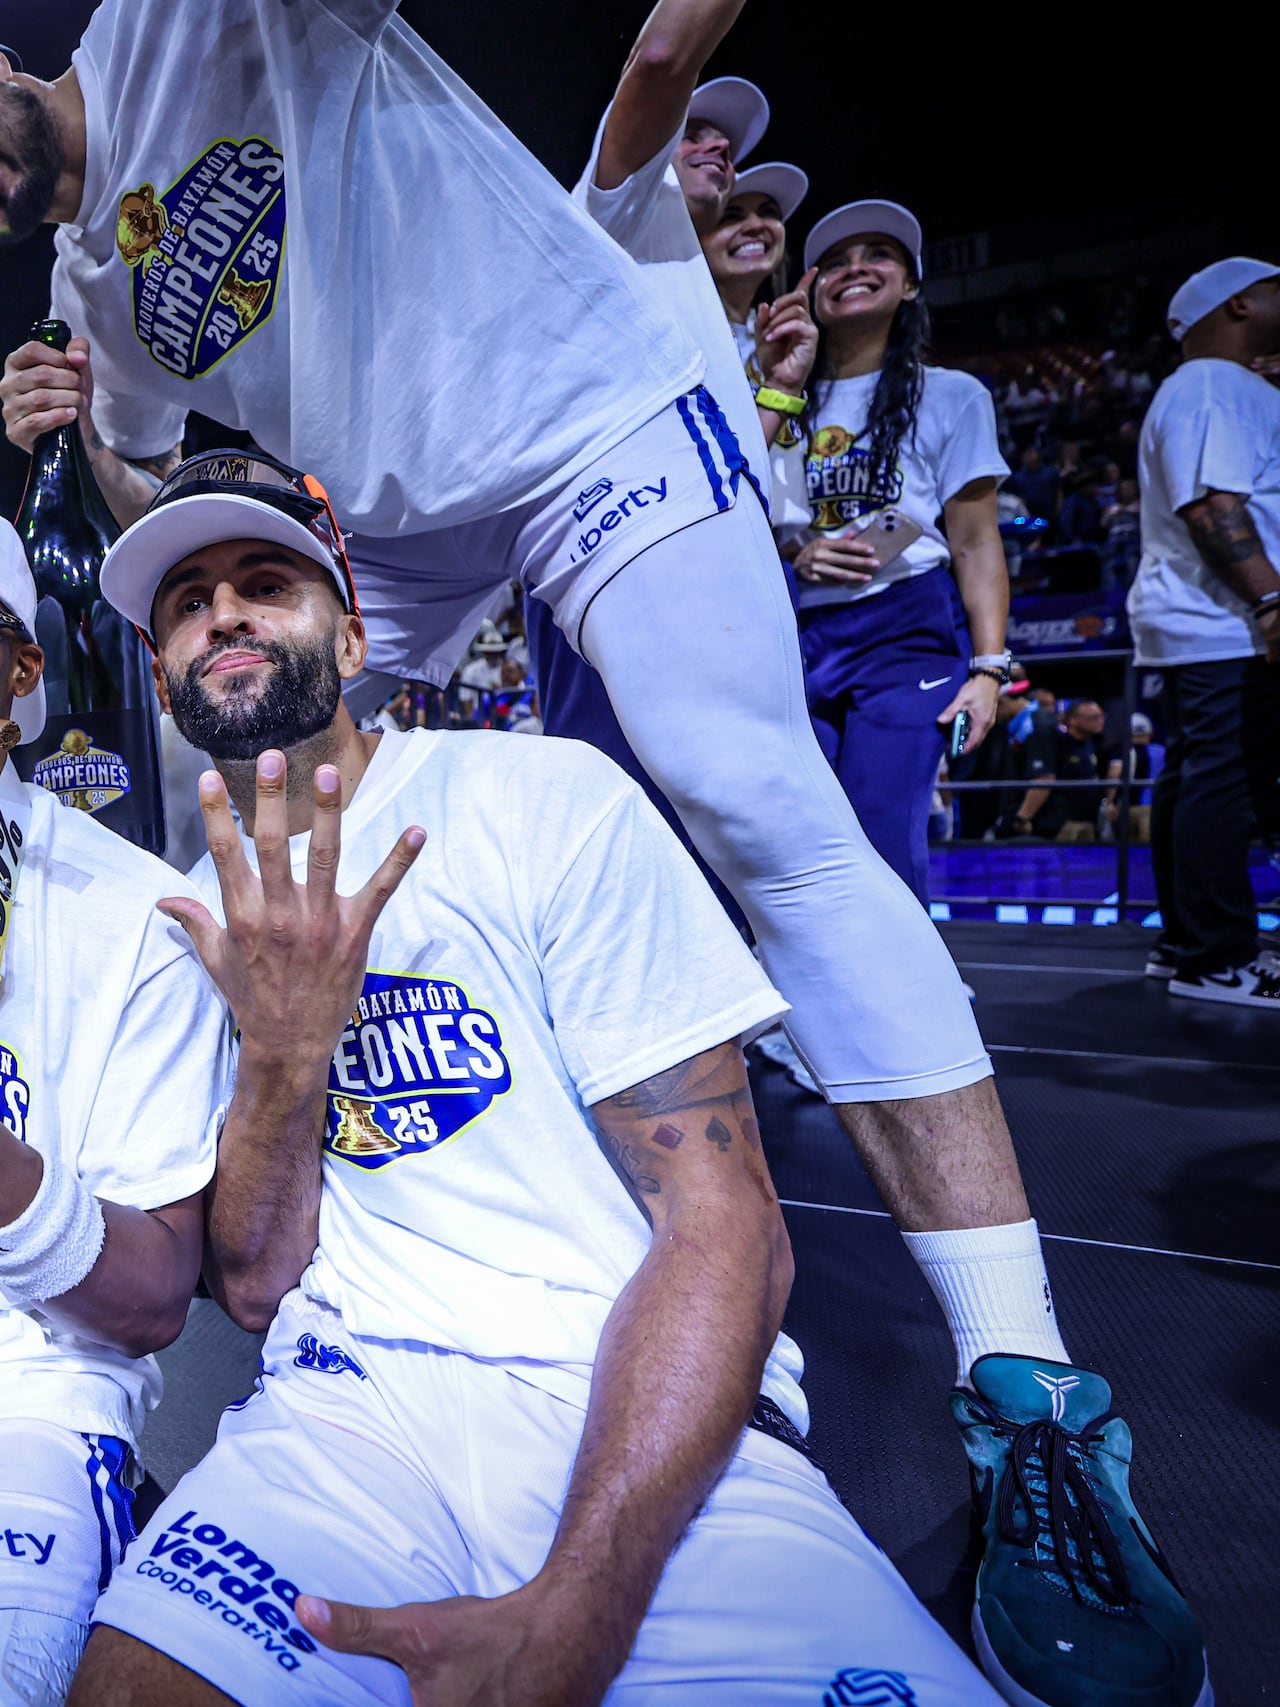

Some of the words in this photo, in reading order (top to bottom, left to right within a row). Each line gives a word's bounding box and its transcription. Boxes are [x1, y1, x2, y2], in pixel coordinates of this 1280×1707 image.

[139, 257, 168, 341] VAQUEROS
[158, 227, 180, 258] DE
[172, 143, 236, 228] BAYAMÓN
[151, 143, 285, 374] CAMPEONES
[205, 310, 239, 349] 20
[242, 231, 279, 275] 25
[34, 763, 129, 791] CAMPEONES
[91, 791, 105, 804] 25
[360, 982, 462, 1020] BAYAMÓN
[333, 1013, 505, 1090] EONES
[388, 1100, 439, 1143] 25
[136, 1560, 301, 1672] Cooperativa
[149, 1533, 318, 1654] Verdes
